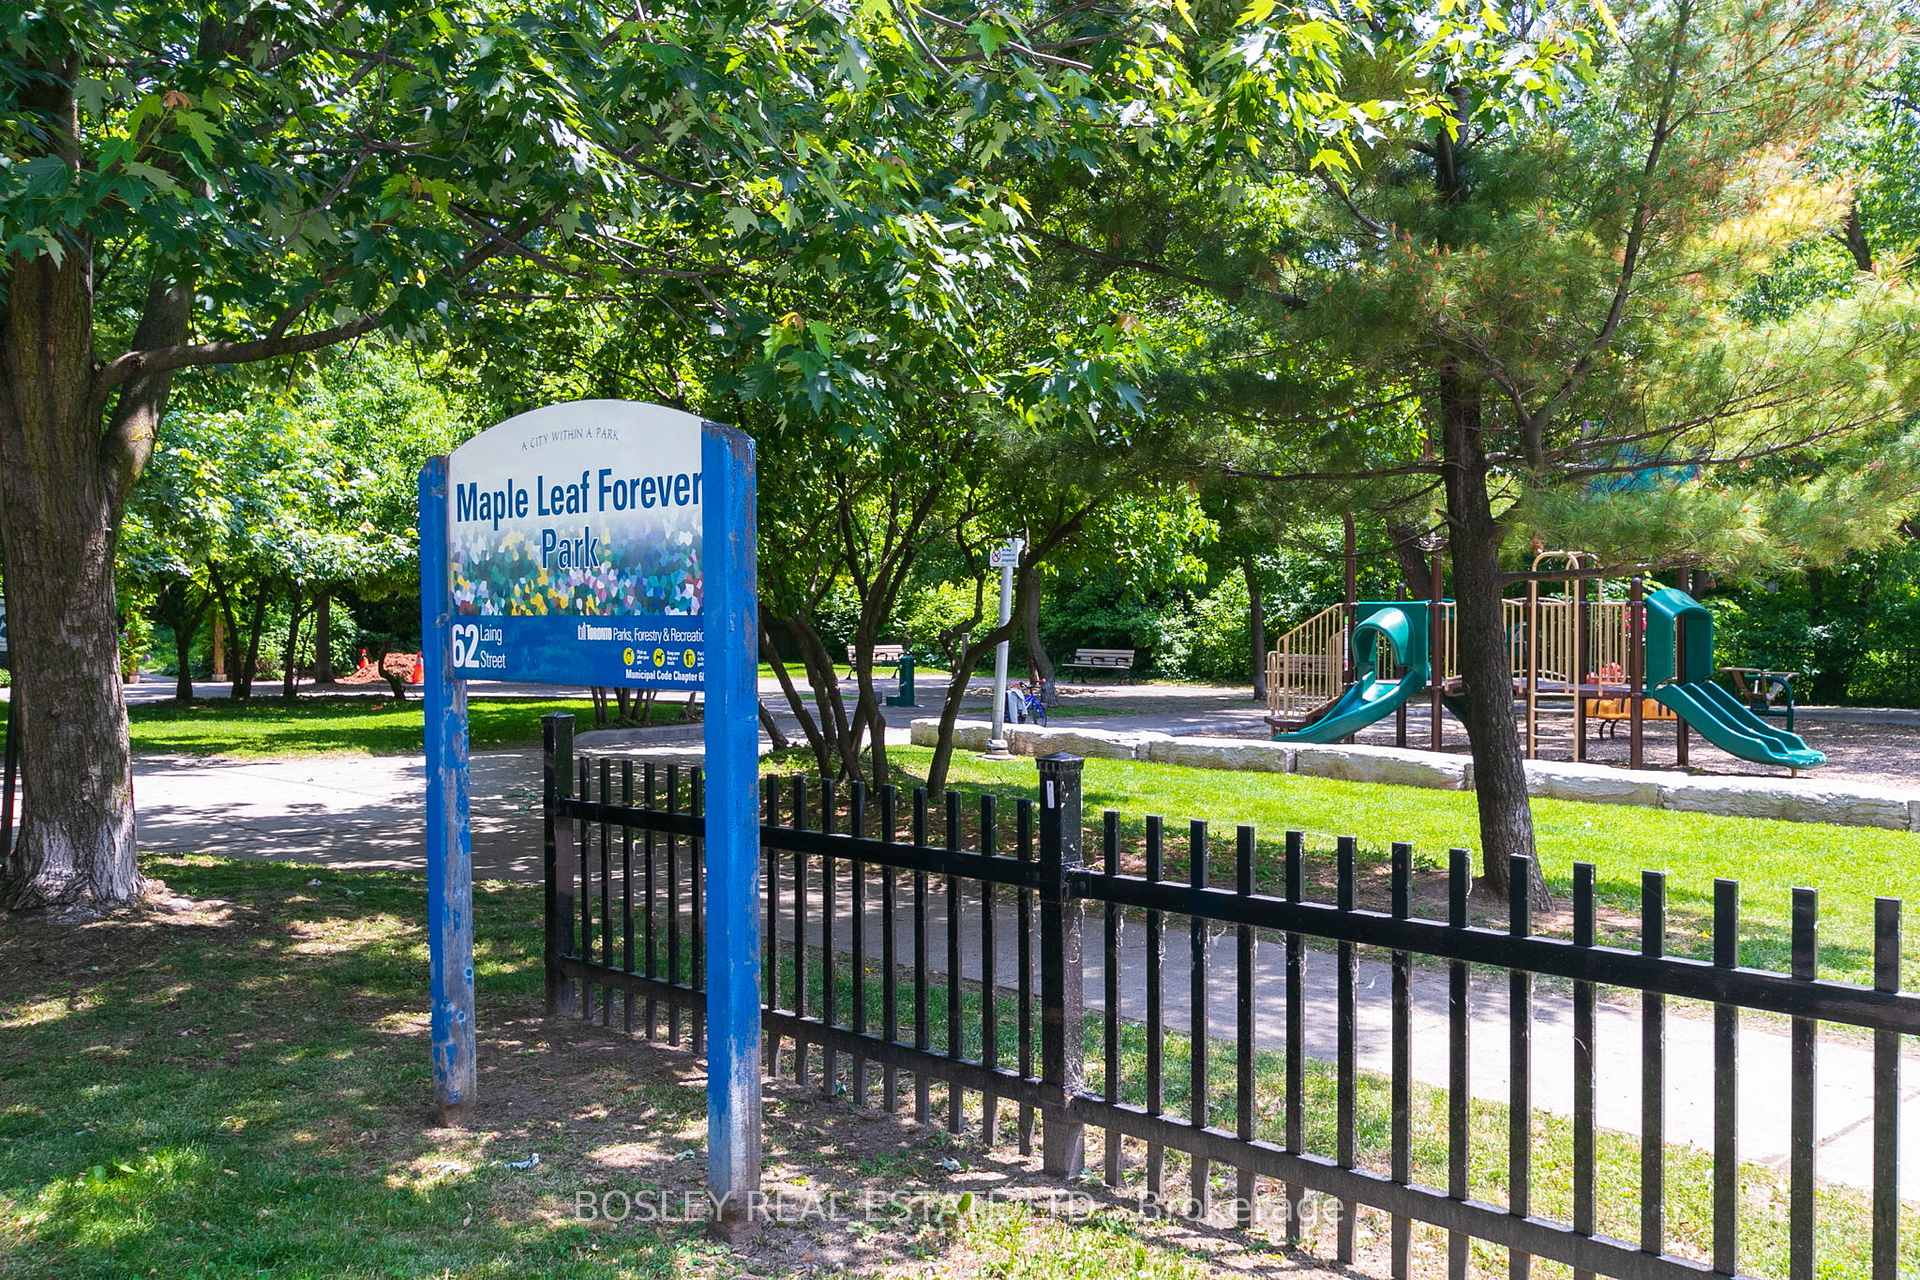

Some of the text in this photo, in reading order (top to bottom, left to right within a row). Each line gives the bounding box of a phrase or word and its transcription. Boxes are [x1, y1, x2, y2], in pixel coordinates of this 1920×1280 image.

[521, 427, 620, 451] A CITY WITHIN A PARK
[457, 468, 703, 531] Maple Leaf Forever
[542, 526, 599, 569] Park
[452, 624, 480, 668] 62
[480, 624, 503, 646] Laing
[613, 627, 634, 642] Parks,
[634, 627, 662, 644] Forestry
[663, 627, 670, 642] &
[480, 650, 506, 669] Street
[625, 669, 656, 682] Municipal
[656, 670, 673, 681] Code
[673, 671, 698, 684] Chapter
